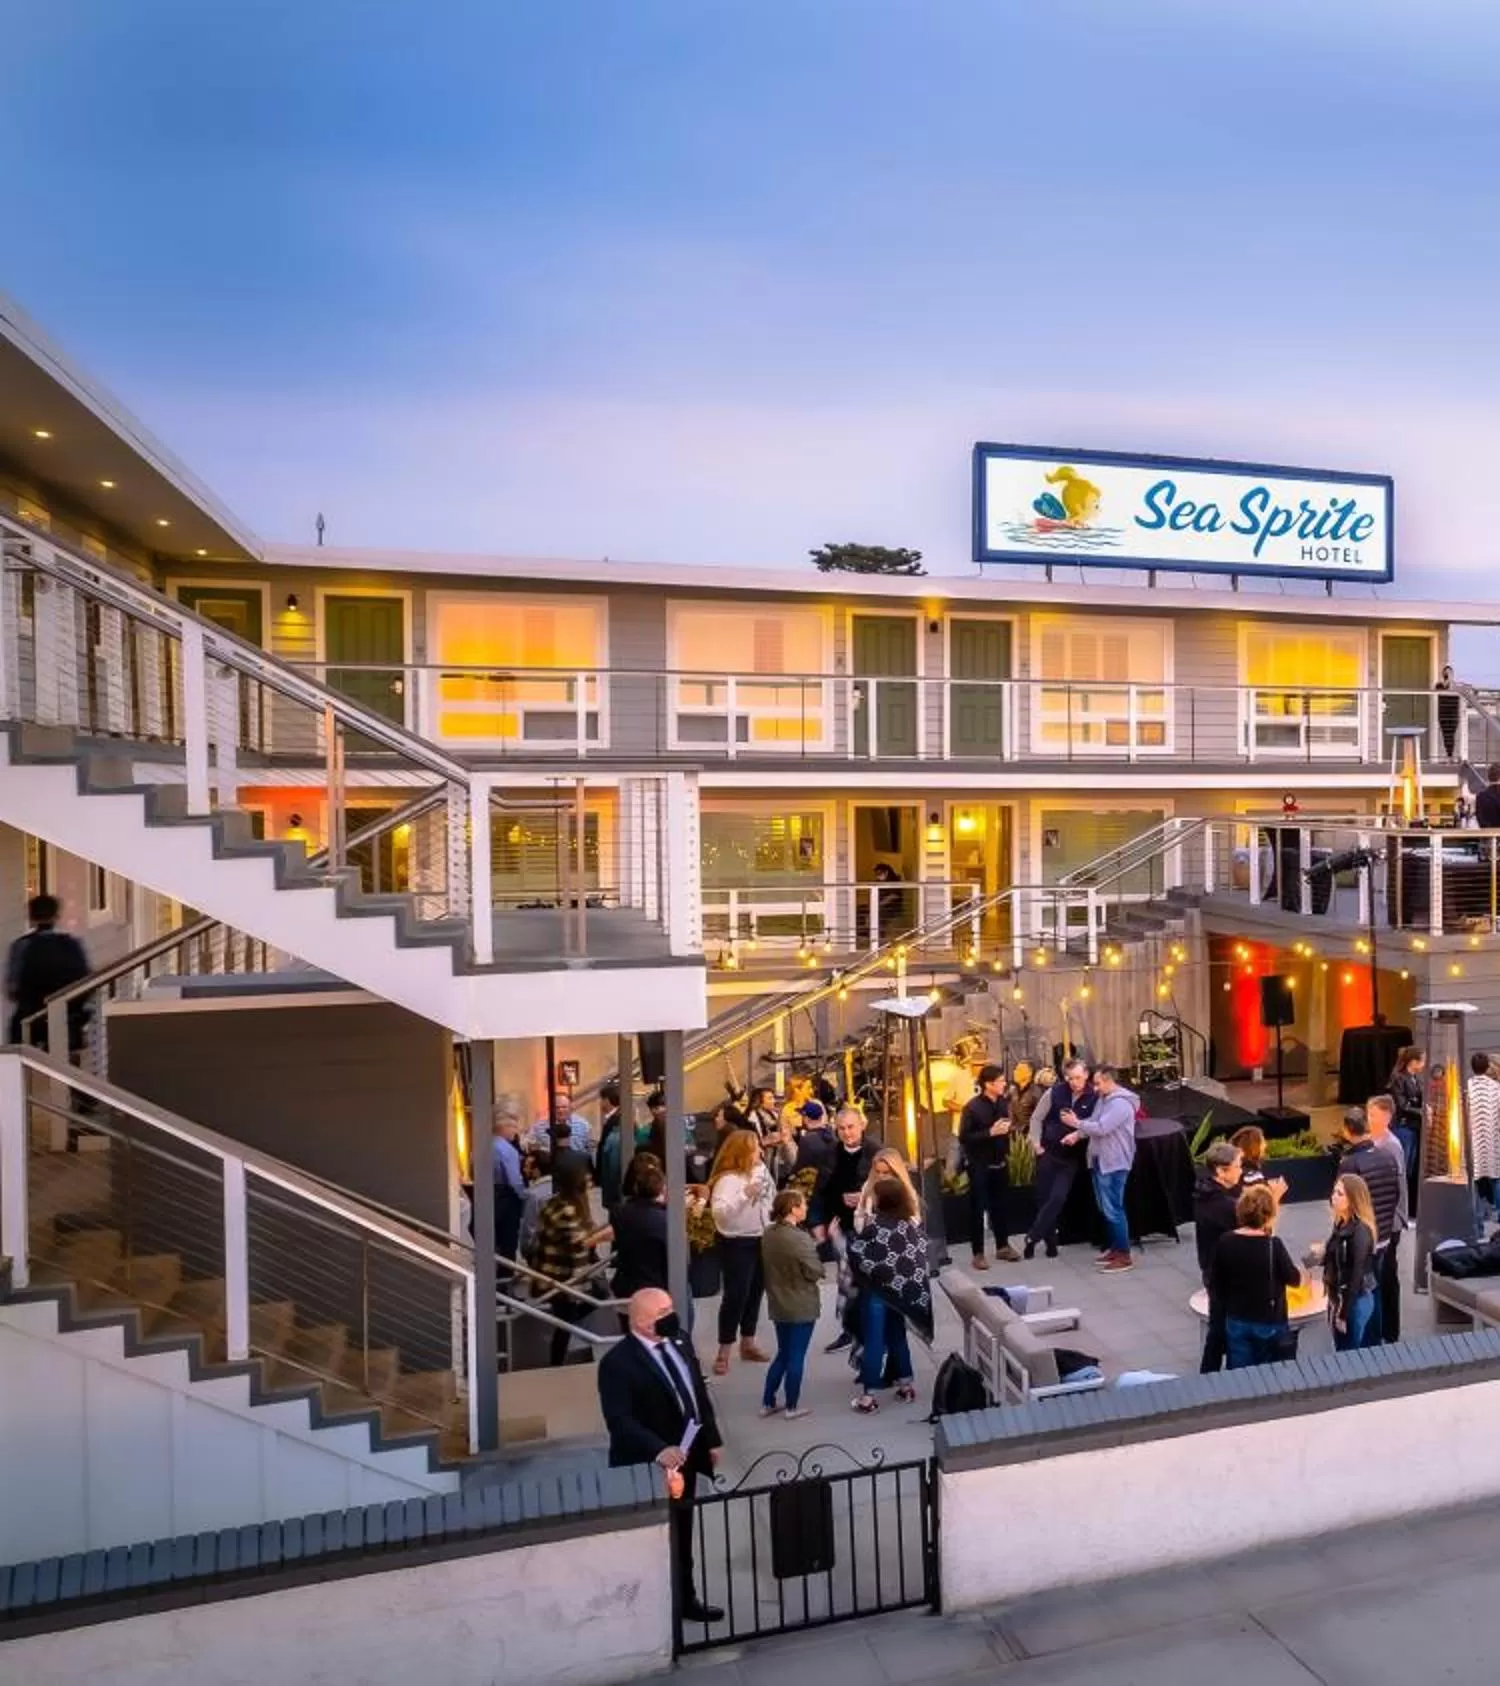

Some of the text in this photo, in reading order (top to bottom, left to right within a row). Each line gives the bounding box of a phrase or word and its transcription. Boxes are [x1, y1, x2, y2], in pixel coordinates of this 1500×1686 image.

[1134, 479, 1375, 557] Sea Sprite
[1301, 545, 1362, 564] HOTEL
